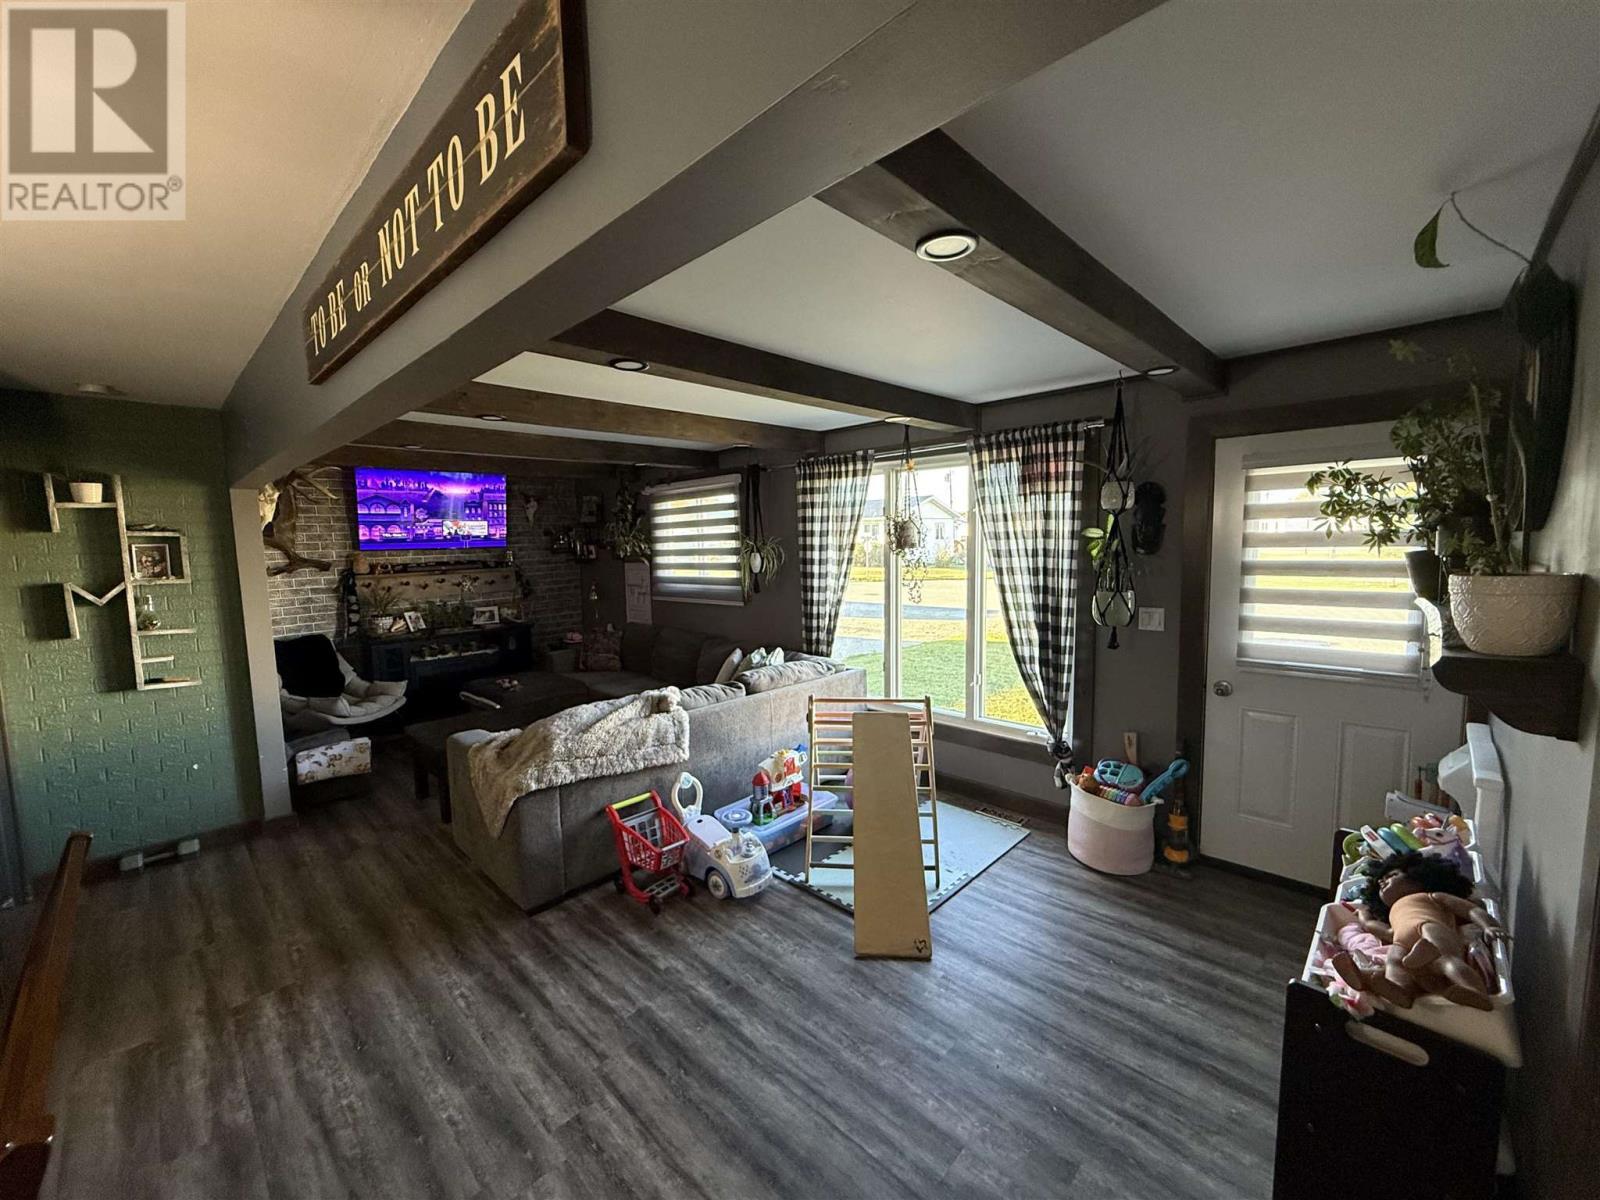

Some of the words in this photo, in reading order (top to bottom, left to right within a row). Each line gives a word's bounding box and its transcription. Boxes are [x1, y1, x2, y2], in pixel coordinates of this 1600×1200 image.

[310, 305, 326, 356] TO
[328, 279, 347, 340] BE
[354, 261, 371, 312] OR
[378, 183, 420, 288] NOT
[427, 134, 465, 232] TO
[475, 52, 526, 186] BE
